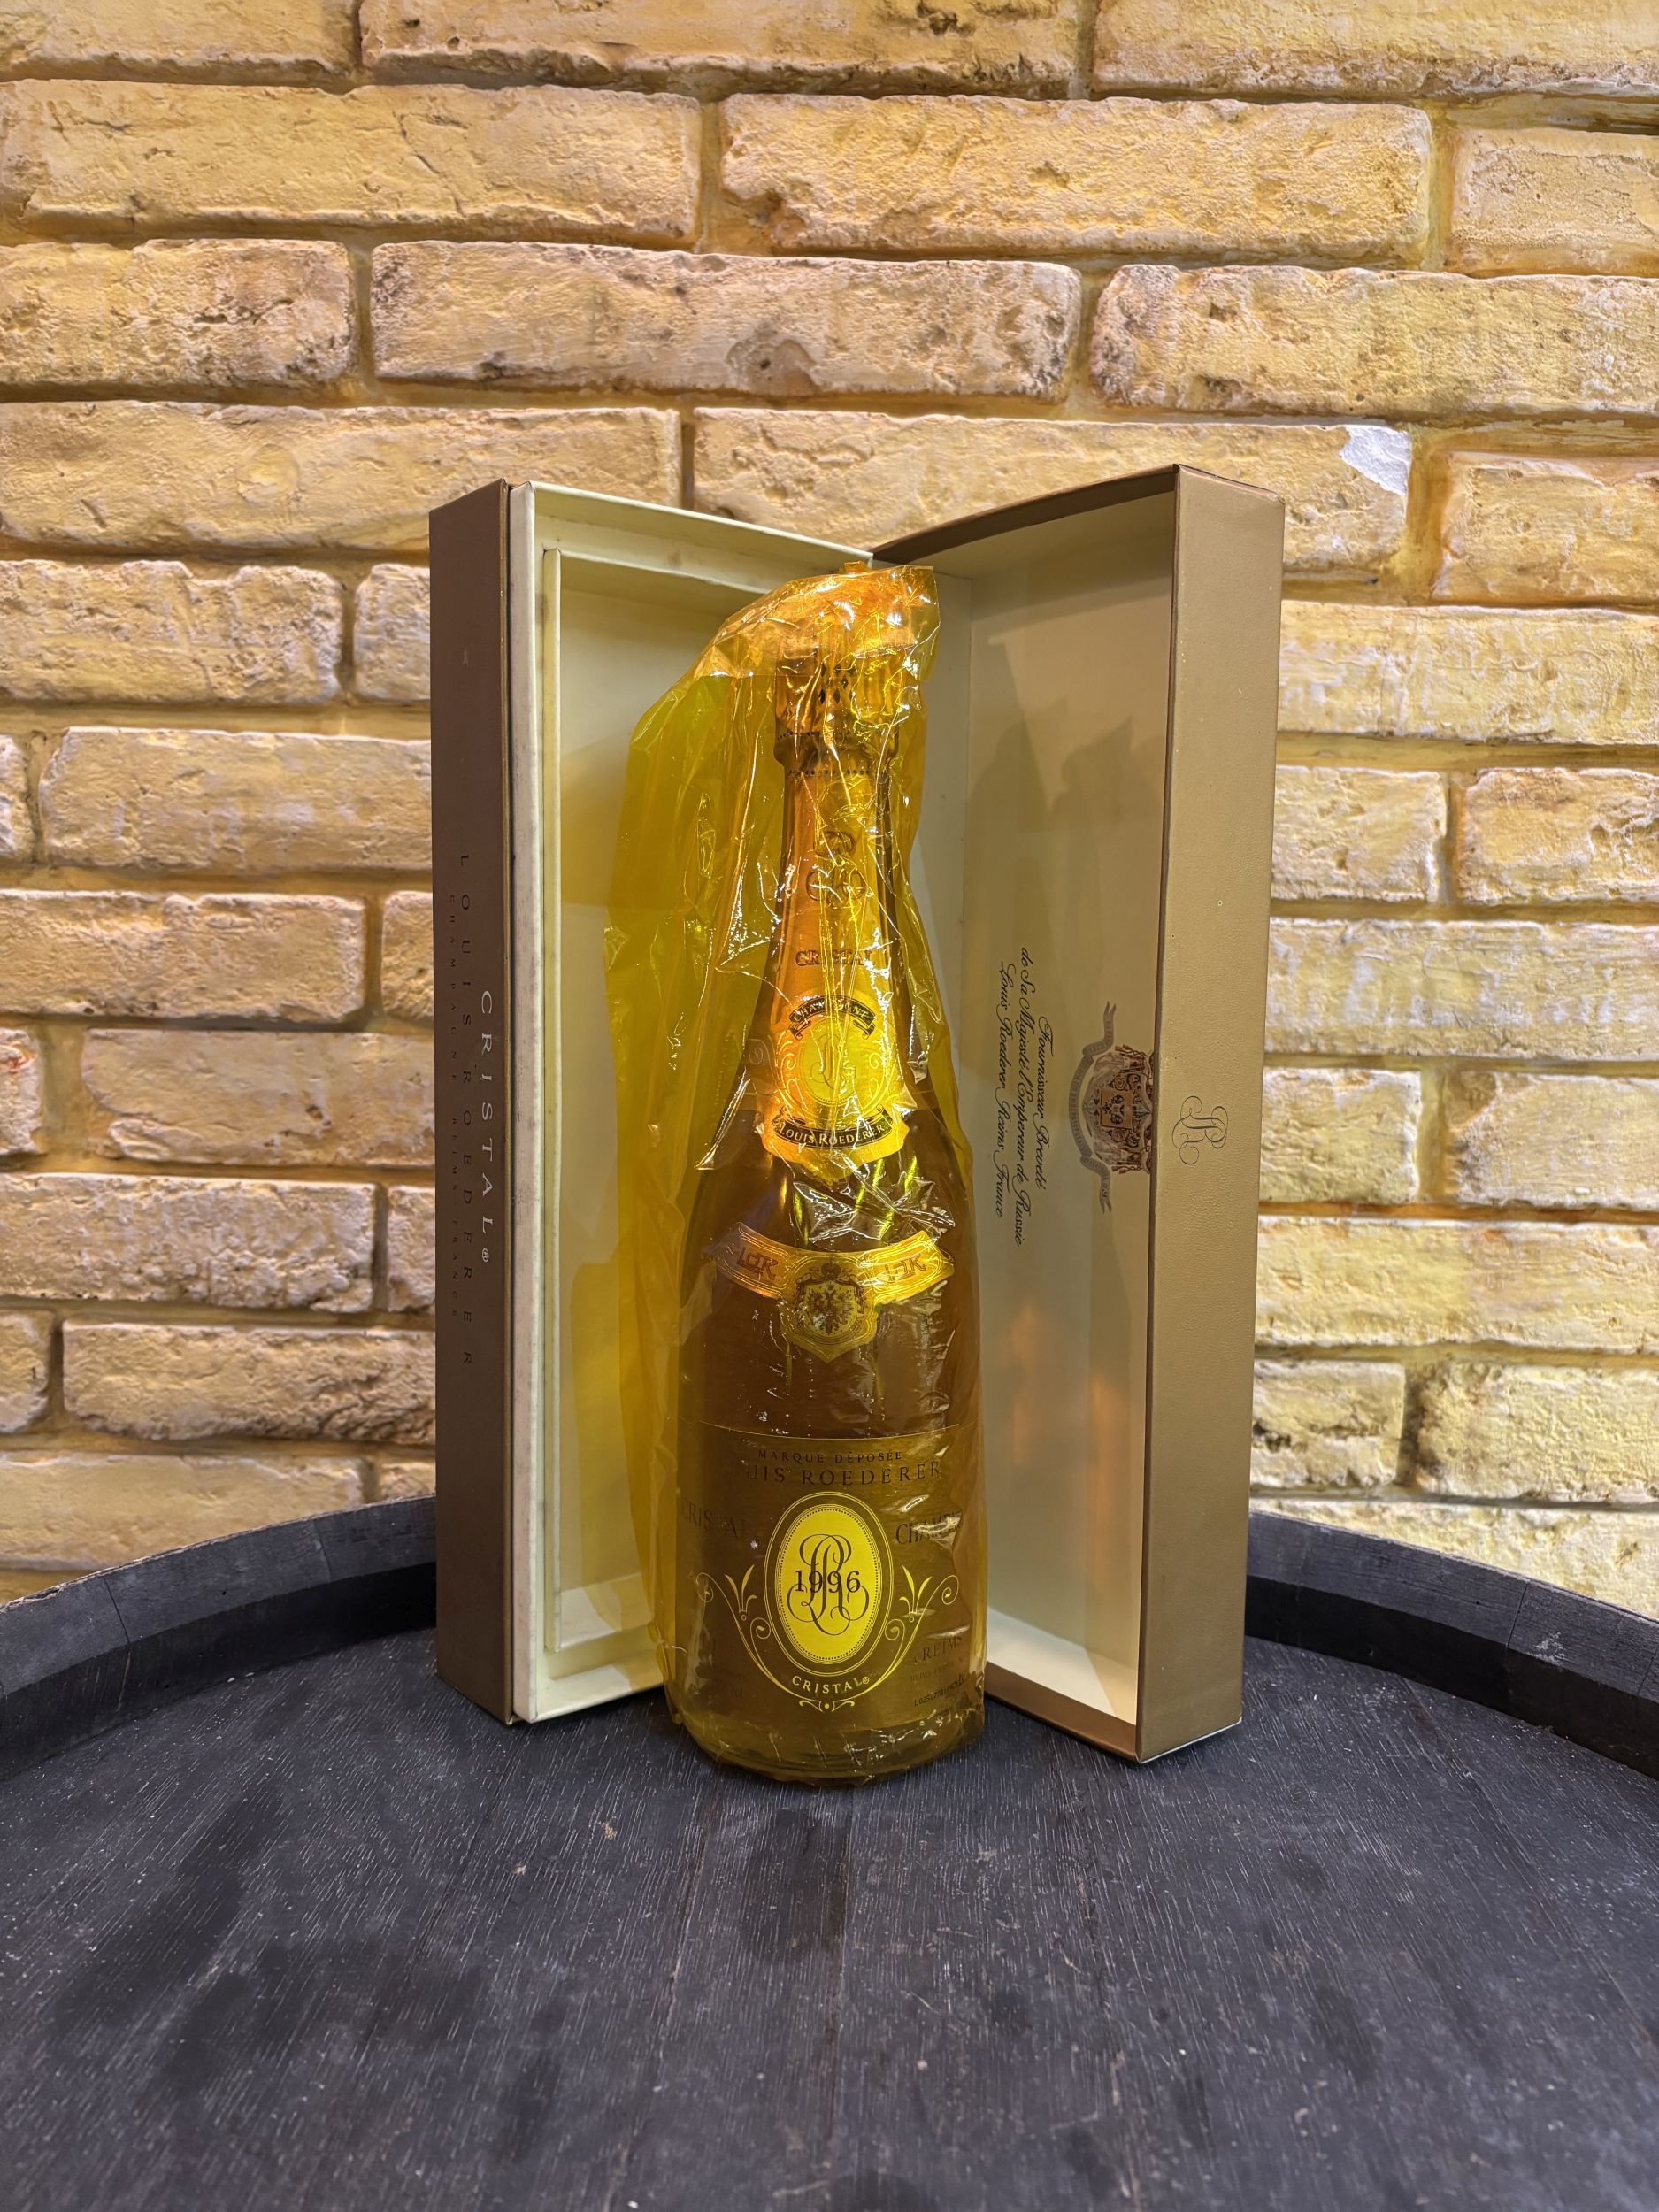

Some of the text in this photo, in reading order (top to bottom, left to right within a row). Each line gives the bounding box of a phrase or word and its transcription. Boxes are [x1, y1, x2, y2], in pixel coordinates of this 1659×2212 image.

[1020, 947, 1033, 967] de
[1018, 971, 1035, 995] Sa
[1014, 995, 1033, 1069] Majesté
[994, 960, 1017, 1218] Louis Roederer Reims France
[460, 853, 473, 1367] LOUIS ROEDERER
[1032, 1016, 1055, 1190] Fournisseur Breveté
[780, 1122, 885, 1145] LOUIS ROEDERER
[1016, 1163, 1029, 1182] de
[1010, 1182, 1033, 1246] Russie
[757, 1449, 825, 1464] MARQUE
[802, 1461, 941, 1486] ROEDERER
[794, 1570, 861, 1594] 1996
